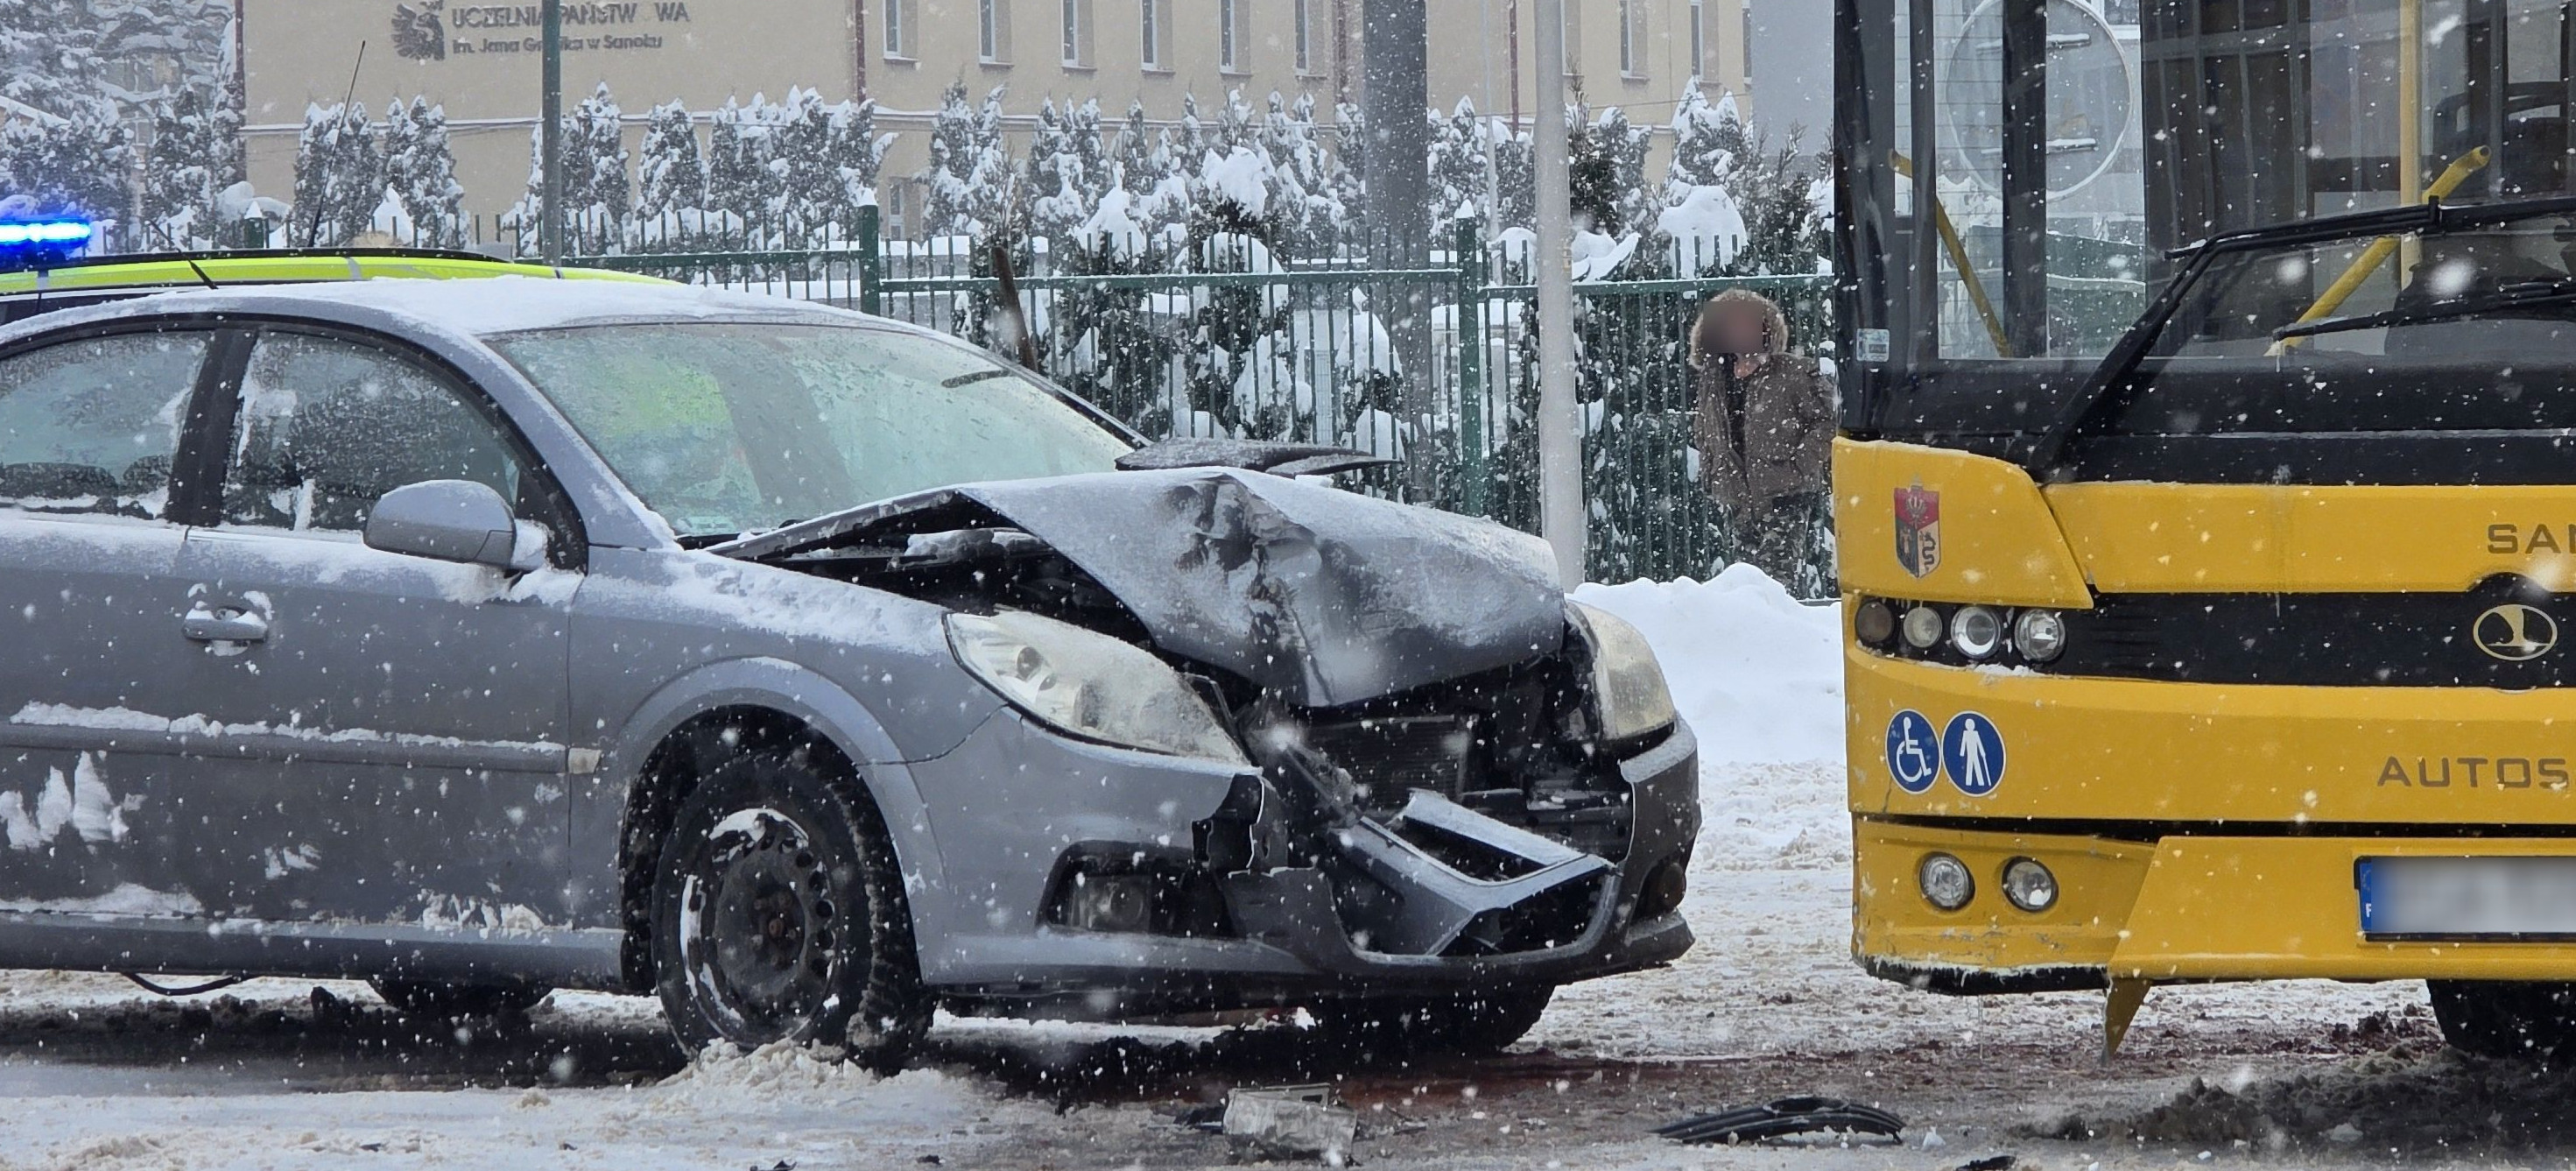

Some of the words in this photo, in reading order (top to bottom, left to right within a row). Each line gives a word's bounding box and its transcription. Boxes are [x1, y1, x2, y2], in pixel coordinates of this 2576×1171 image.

[452, 6, 542, 28] UCZELNI
[479, 38, 519, 53] Jana
[587, 38, 600, 49] w
[603, 33, 662, 49] Sanoku
[2487, 524, 2576, 554] SA
[2377, 756, 2569, 788] AUTOS
